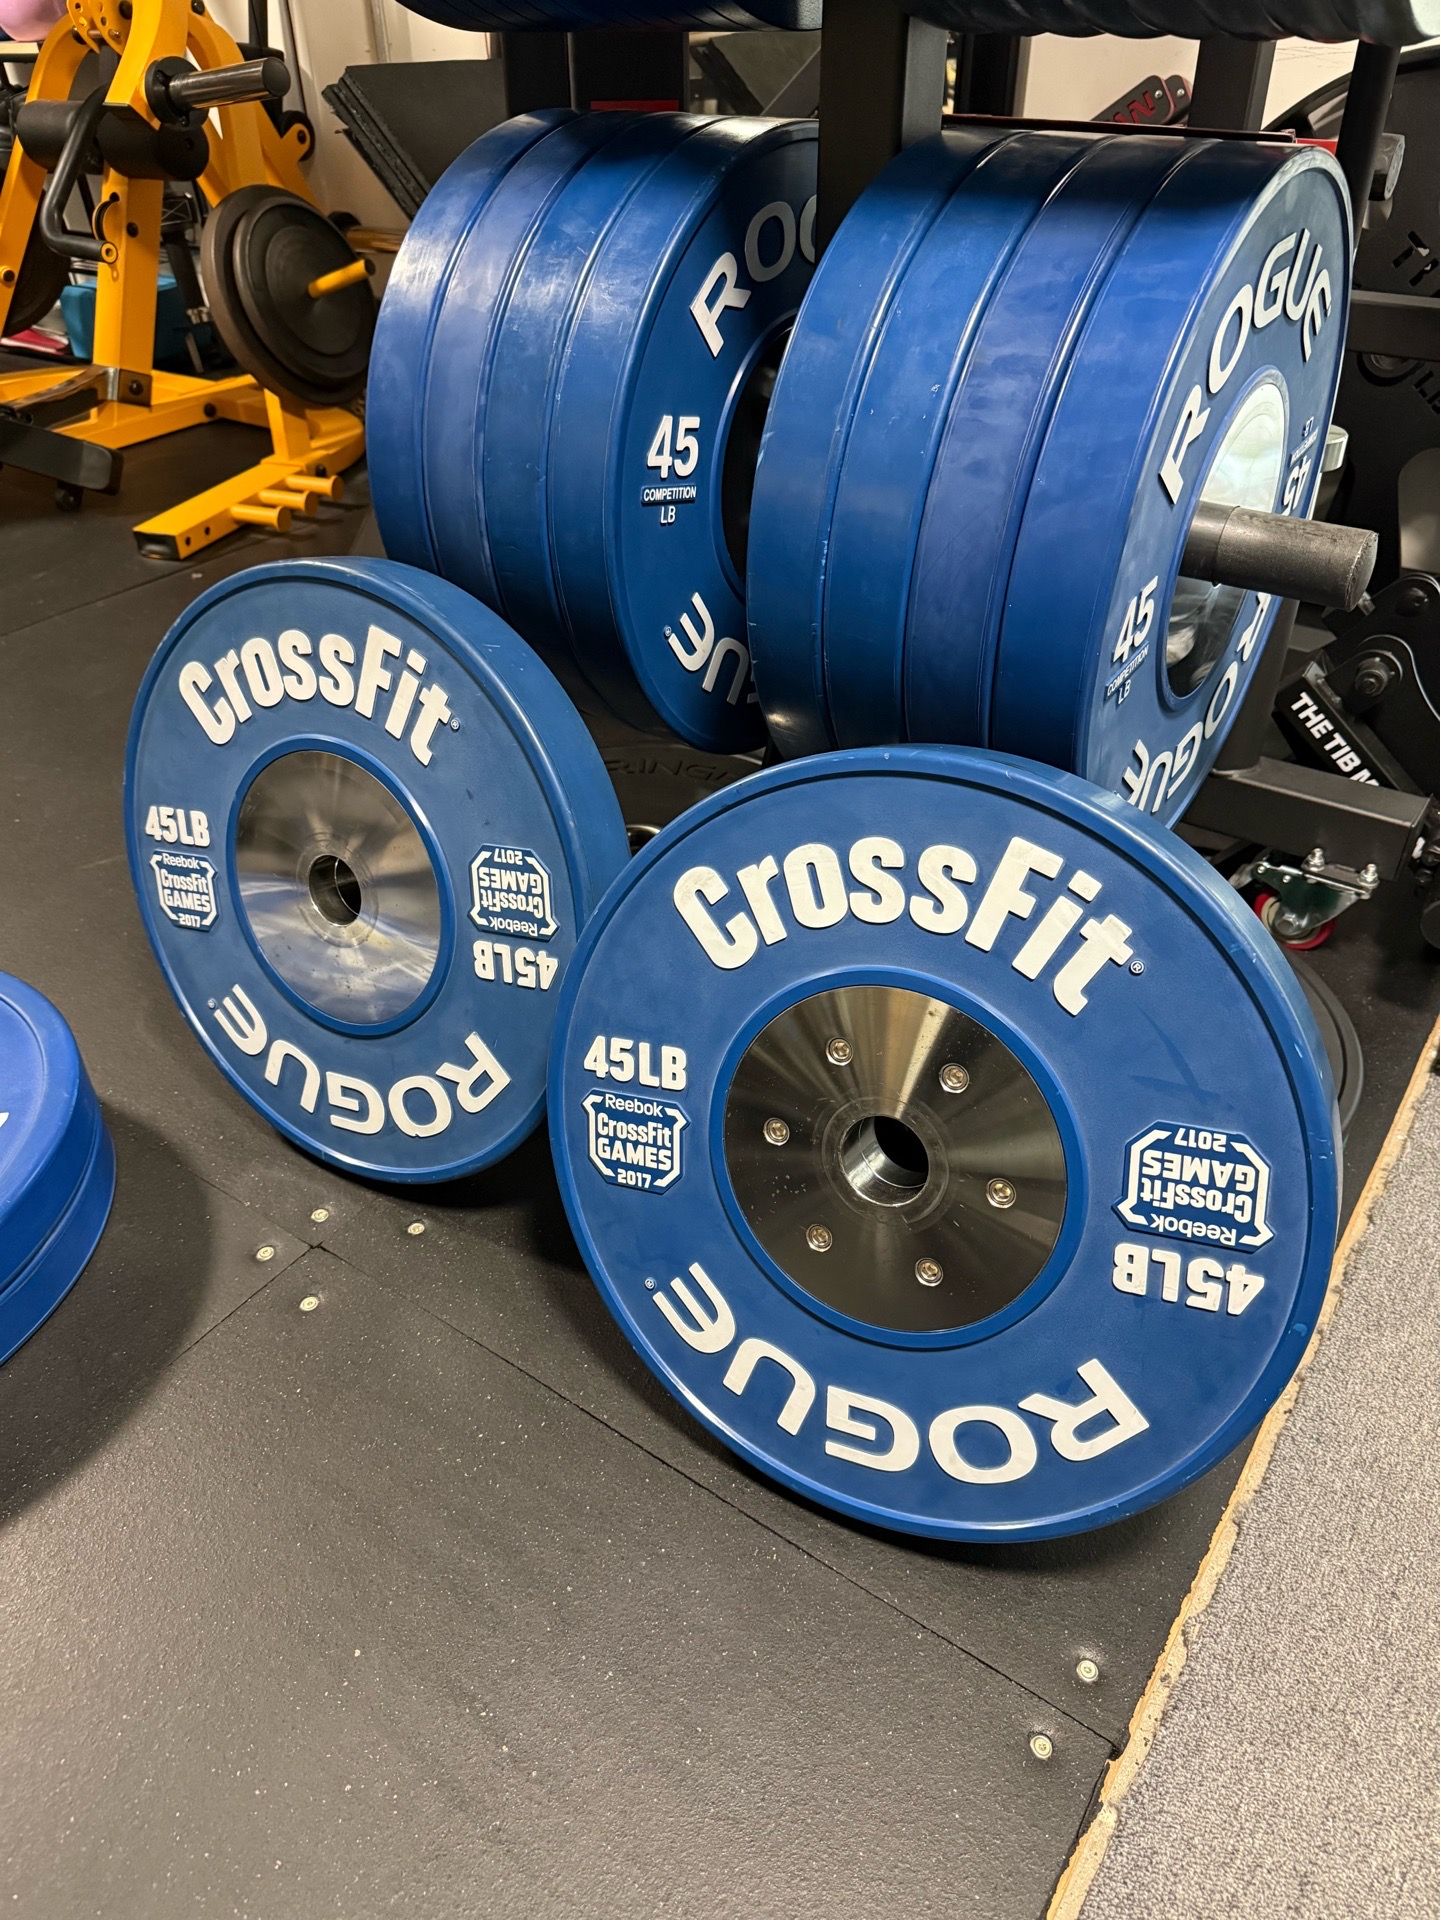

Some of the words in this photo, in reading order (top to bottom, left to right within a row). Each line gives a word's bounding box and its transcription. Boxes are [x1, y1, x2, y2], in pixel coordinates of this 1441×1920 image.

[1157, 227, 1332, 504] ROGUE
[647, 414, 700, 478] 45
[643, 486, 697, 502] COMPETITION
[660, 505, 676, 524] LB
[1113, 575, 1158, 663] 45
[1107, 644, 1150, 697] COMPETITION
[178, 625, 452, 767] CrossFit
[1118, 679, 1132, 705] LB
[1121, 592, 1271, 813] ROGUE
[1290, 691, 1334, 740] THE
[1323, 732, 1362, 773] TIB
[145, 805, 211, 848] 45LB
[161, 853, 201, 870] Reebok
[493, 848, 523, 866] 2017
[160, 868, 208, 893] CrossFit
[478, 866, 543, 896] GAMES
[163, 889, 212, 914] GAMES
[479, 888, 544, 919] CrossFit
[178, 912, 201, 929] 2017
[489, 915, 538, 938] Reebok
[672, 836, 1135, 1017] CrossFit
[472, 940, 559, 991] 45LB
[213, 983, 512, 1138] ROGUE
[583, 1035, 687, 1091] 45LB
[604, 1093, 664, 1118] Reebok
[597, 1112, 672, 1148] CrossFit
[1173, 1127, 1227, 1153] 2017
[597, 1137, 672, 1172] GAMES
[1141, 1149, 1256, 1192] GAMES
[617, 1168, 652, 1189] 2017
[1140, 1177, 1253, 1224] CrossFit
[1150, 1213, 1237, 1247] Reebok
[1112, 1243, 1265, 1316] 45LB
[652, 1261, 1150, 1485] ROGUE
